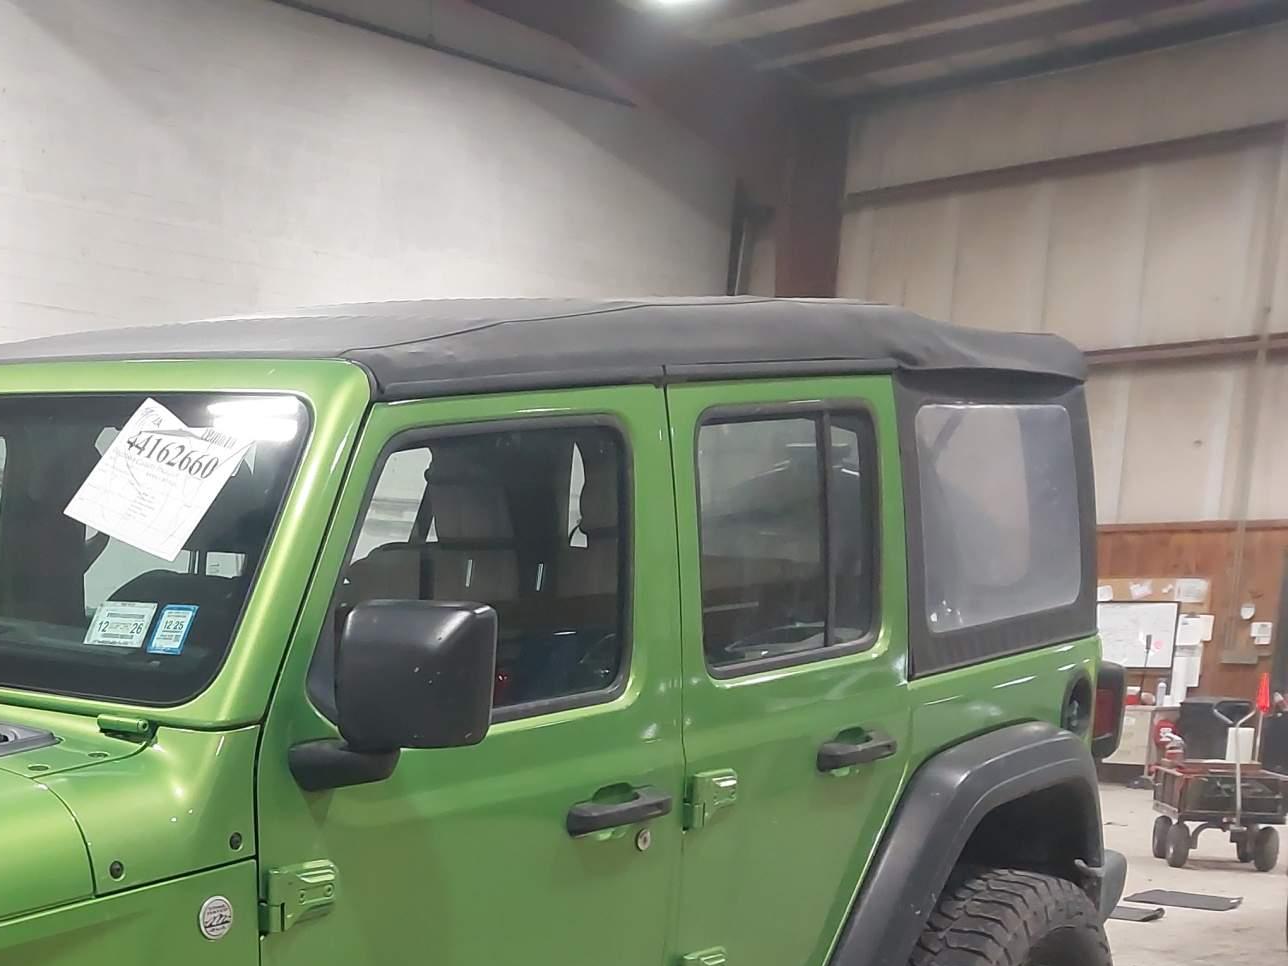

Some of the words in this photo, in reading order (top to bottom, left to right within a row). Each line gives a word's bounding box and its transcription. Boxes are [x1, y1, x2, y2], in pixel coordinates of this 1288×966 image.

[126, 434, 220, 480] 44162660
[98, 620, 110, 633] 12
[129, 622, 144, 634] 26
